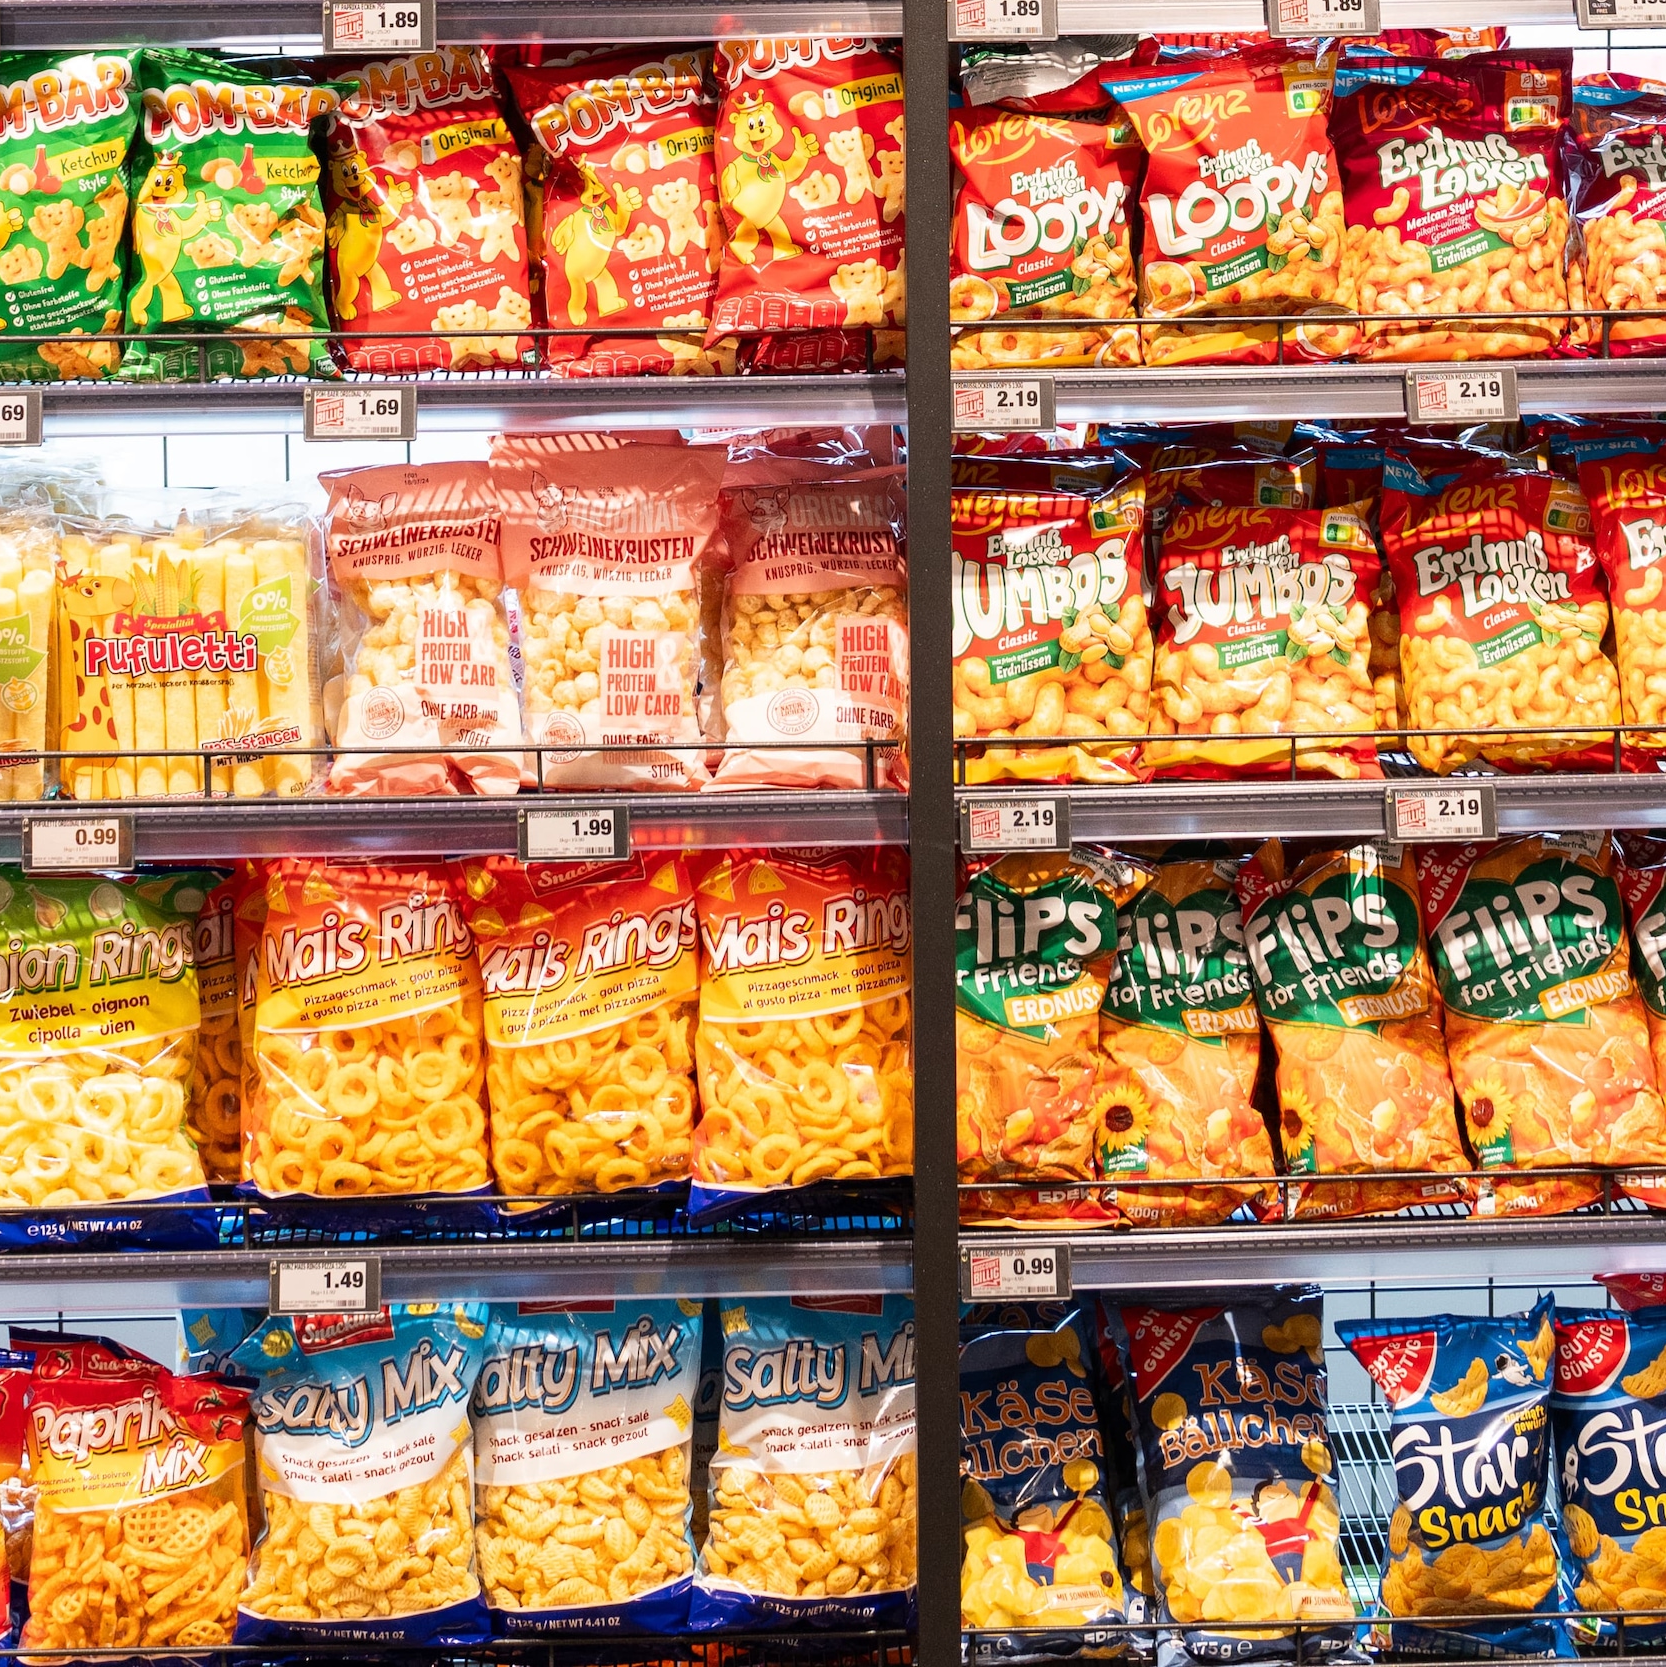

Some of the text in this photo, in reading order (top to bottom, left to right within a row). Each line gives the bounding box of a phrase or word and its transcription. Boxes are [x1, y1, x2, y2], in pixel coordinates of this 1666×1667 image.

[377, 11, 418, 28] 1.89
[958, 9, 985, 25] BILLIG
[999, 0, 1040, 17] 1.89
[335, 21, 363, 38] BILLIG
[1111, 75, 1178, 95] NEW SIZE
[1133, 90, 1249, 151] Lorenz
[437, 123, 497, 145] Original
[59, 150, 118, 173] Ketchup
[78, 175, 107, 190] Style
[1210, 235, 1245, 256] Classic
[412, 253, 449, 268] Glutenfrei
[1211, 257, 1261, 285] Erdnüssen
[997, 391, 1038, 408] 2.19
[531, 537, 694, 565] SCHWEINEKRUSTEN
[1416, 533, 1544, 594] Erdnuß
[1165, 555, 1356, 643] JUMBOS
[1464, 564, 1570, 613] Locken
[86, 632, 259, 674] Pufuletti
[607, 639, 655, 669] HIGH
[607, 674, 656, 692] PROTEIN
[607, 695, 680, 716] LOW CARB
[1439, 799, 1479, 816] 2.19
[571, 820, 612, 836] 1.99
[265, 917, 368, 986] Mais
[1461, 934, 1612, 1006] for Friends
[304, 964, 463, 1008] Pizzageschmack goût pizza
[1545, 970, 1628, 1013] ERDNUSS
[10, 992, 150, 1025] Zwiebel oignon
[28, 1017, 135, 1045] cipolla uien
[1013, 1257, 1053, 1276] 0.99
[489, 1426, 577, 1448] Snack gesalzen
[491, 1444, 560, 1465] Snack salati
